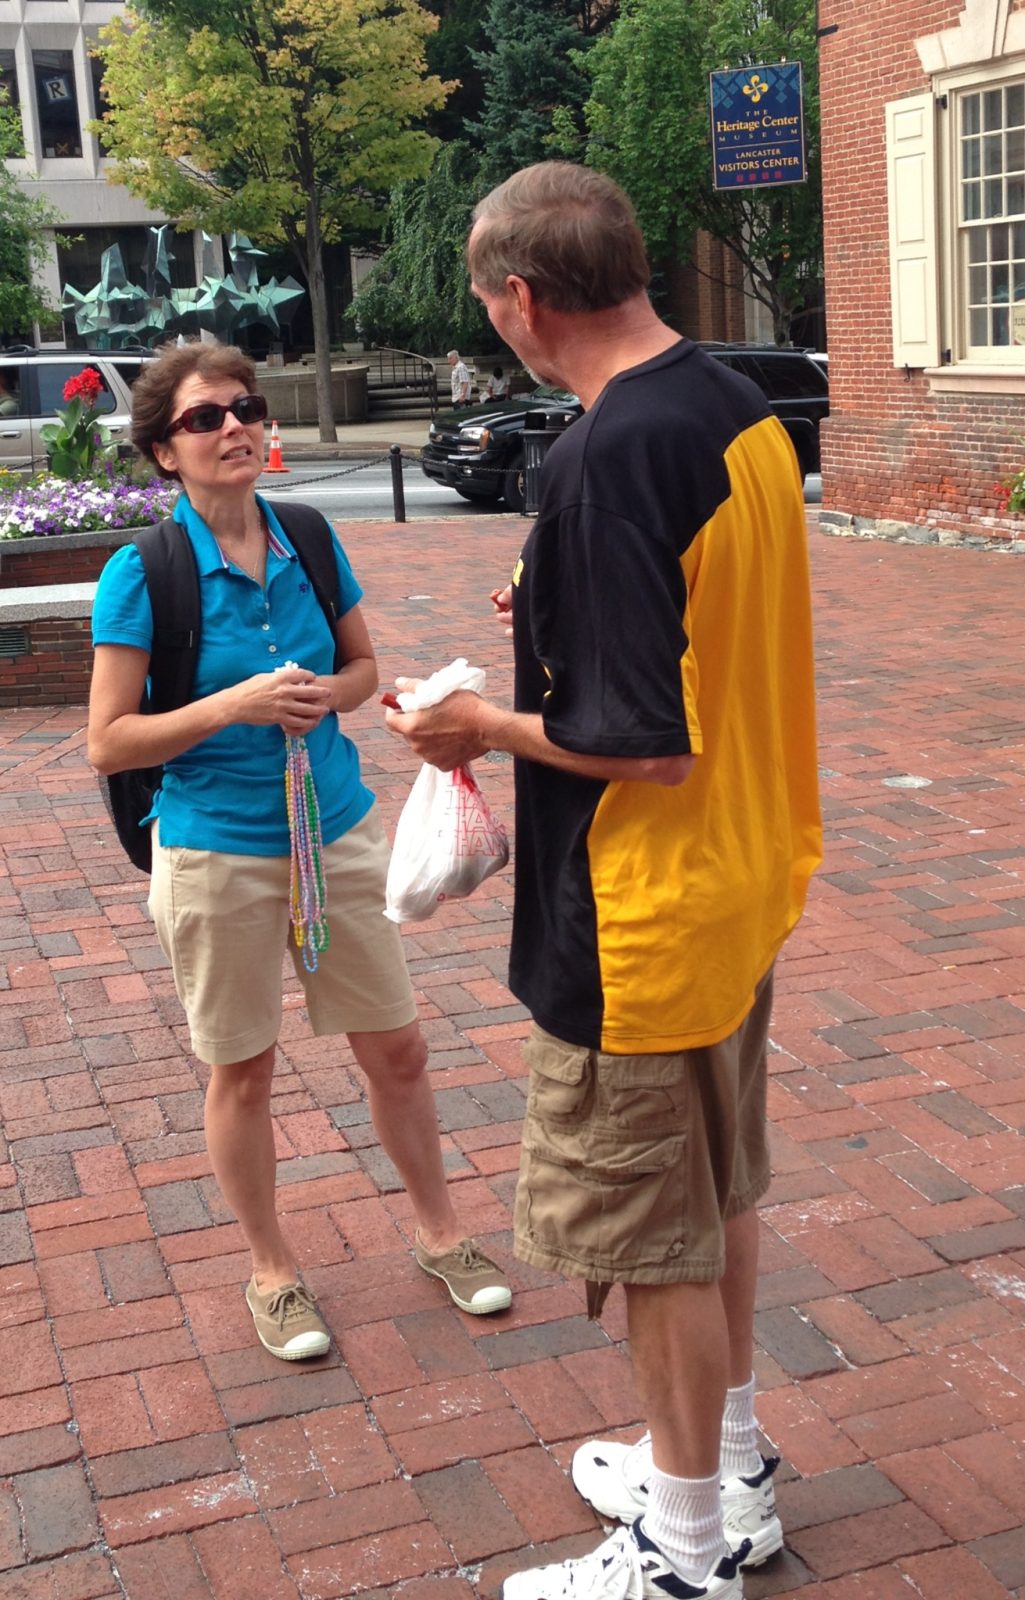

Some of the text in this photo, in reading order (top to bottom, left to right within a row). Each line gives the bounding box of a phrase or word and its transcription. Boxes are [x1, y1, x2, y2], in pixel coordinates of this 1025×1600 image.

[717, 116, 798, 132] Heritage Center
[720, 128, 798, 142] MUSEUM
[736, 148, 781, 158] LANCASTER
[718, 156, 799, 172] VISITORS CENTER
